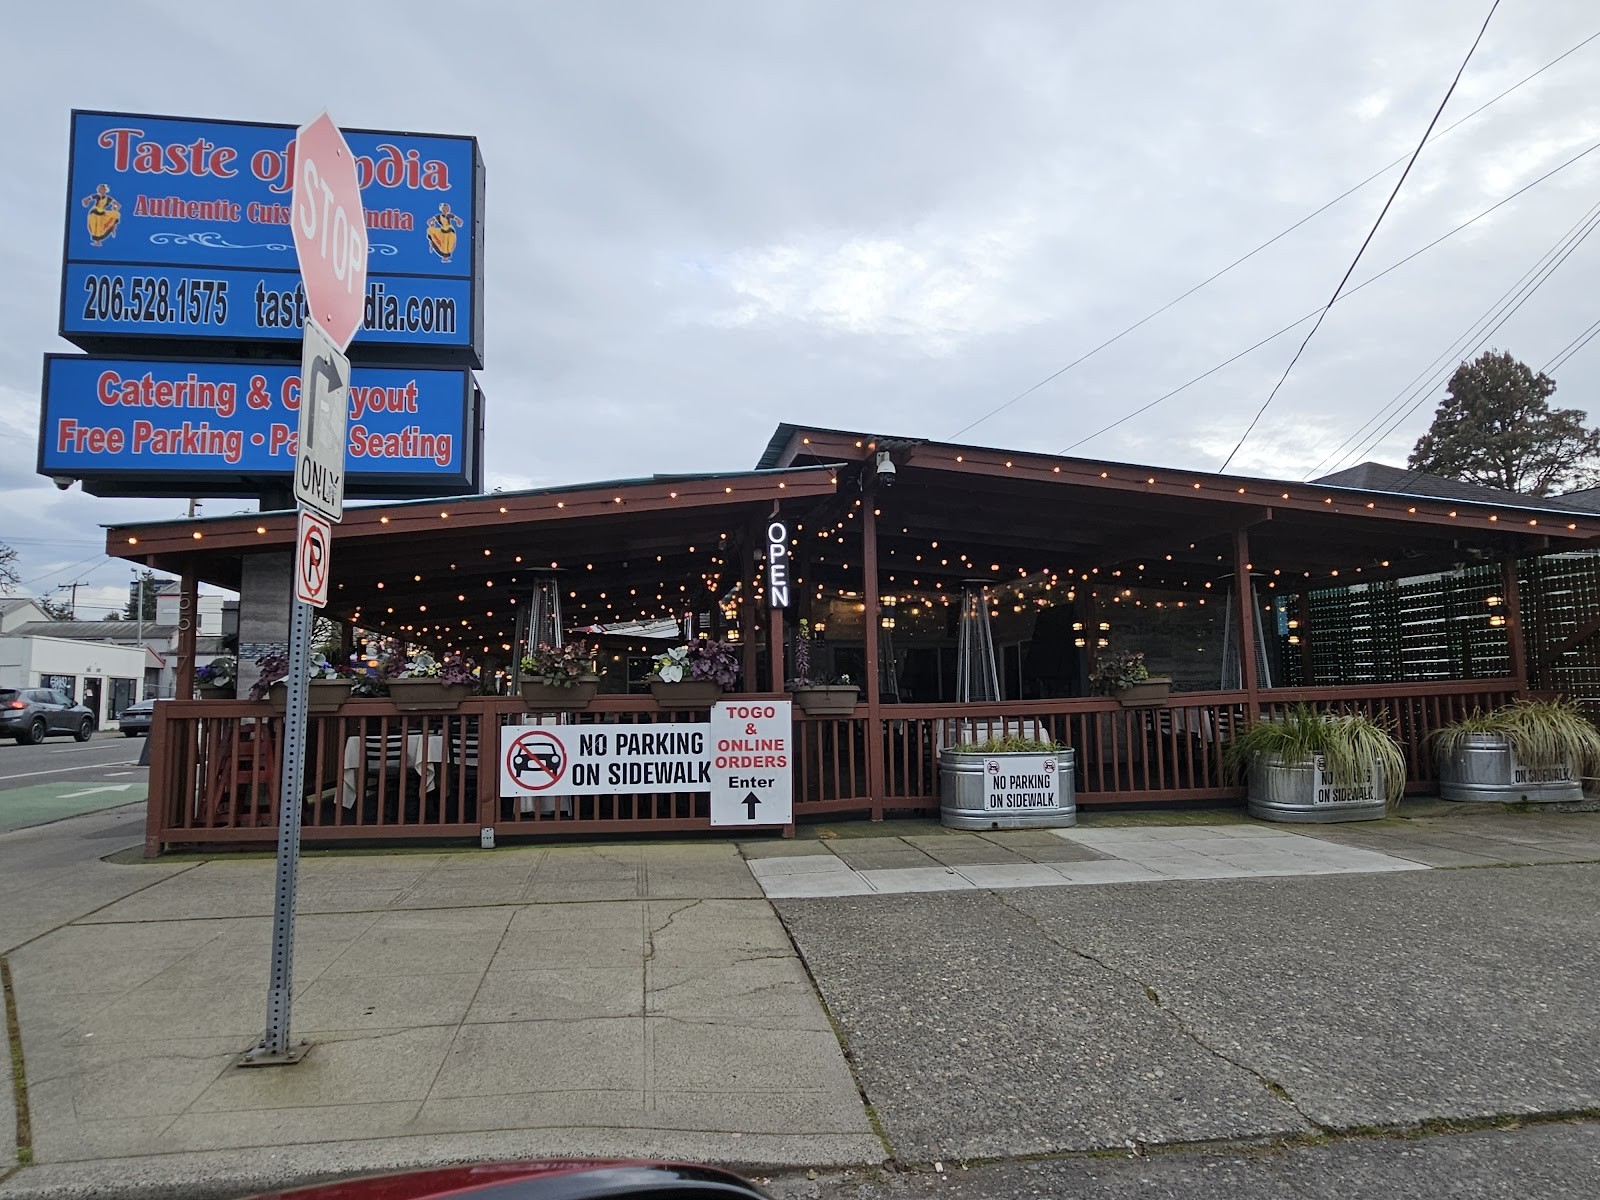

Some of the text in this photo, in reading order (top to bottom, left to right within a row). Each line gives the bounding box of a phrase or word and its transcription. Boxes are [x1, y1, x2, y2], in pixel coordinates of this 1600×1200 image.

[97, 128, 451, 193] Taste of ndia
[134, 195, 241, 223] Authentic
[247, 201, 292, 225] Cuis
[299, 158, 362, 294] STOP
[83, 275, 228, 325] 206.528.1575
[97, 370, 418, 419] Catering & Cyout
[57, 418, 125, 453] Free
[132, 420, 243, 464] Parking
[348, 425, 452, 467] Seating
[302, 455, 340, 506] ONLY
[768, 522, 789, 607] OPEN
[726, 706, 775, 719] TOGO
[745, 722, 757, 735] &
[580, 732, 704, 756] NO PARKING
[717, 739, 784, 752] ONLINE
[714, 756, 787, 769] ORDERS
[572, 761, 711, 786] ON SIDEWALK
[728, 776, 775, 789] Enter
[993, 774, 1050, 790] NO PARKING
[1321, 771, 1333, 785] NO
[1515, 769, 1527, 783] ON
[990, 792, 1054, 808] ON SIDEWALK
[1318, 788, 1330, 803] ON
